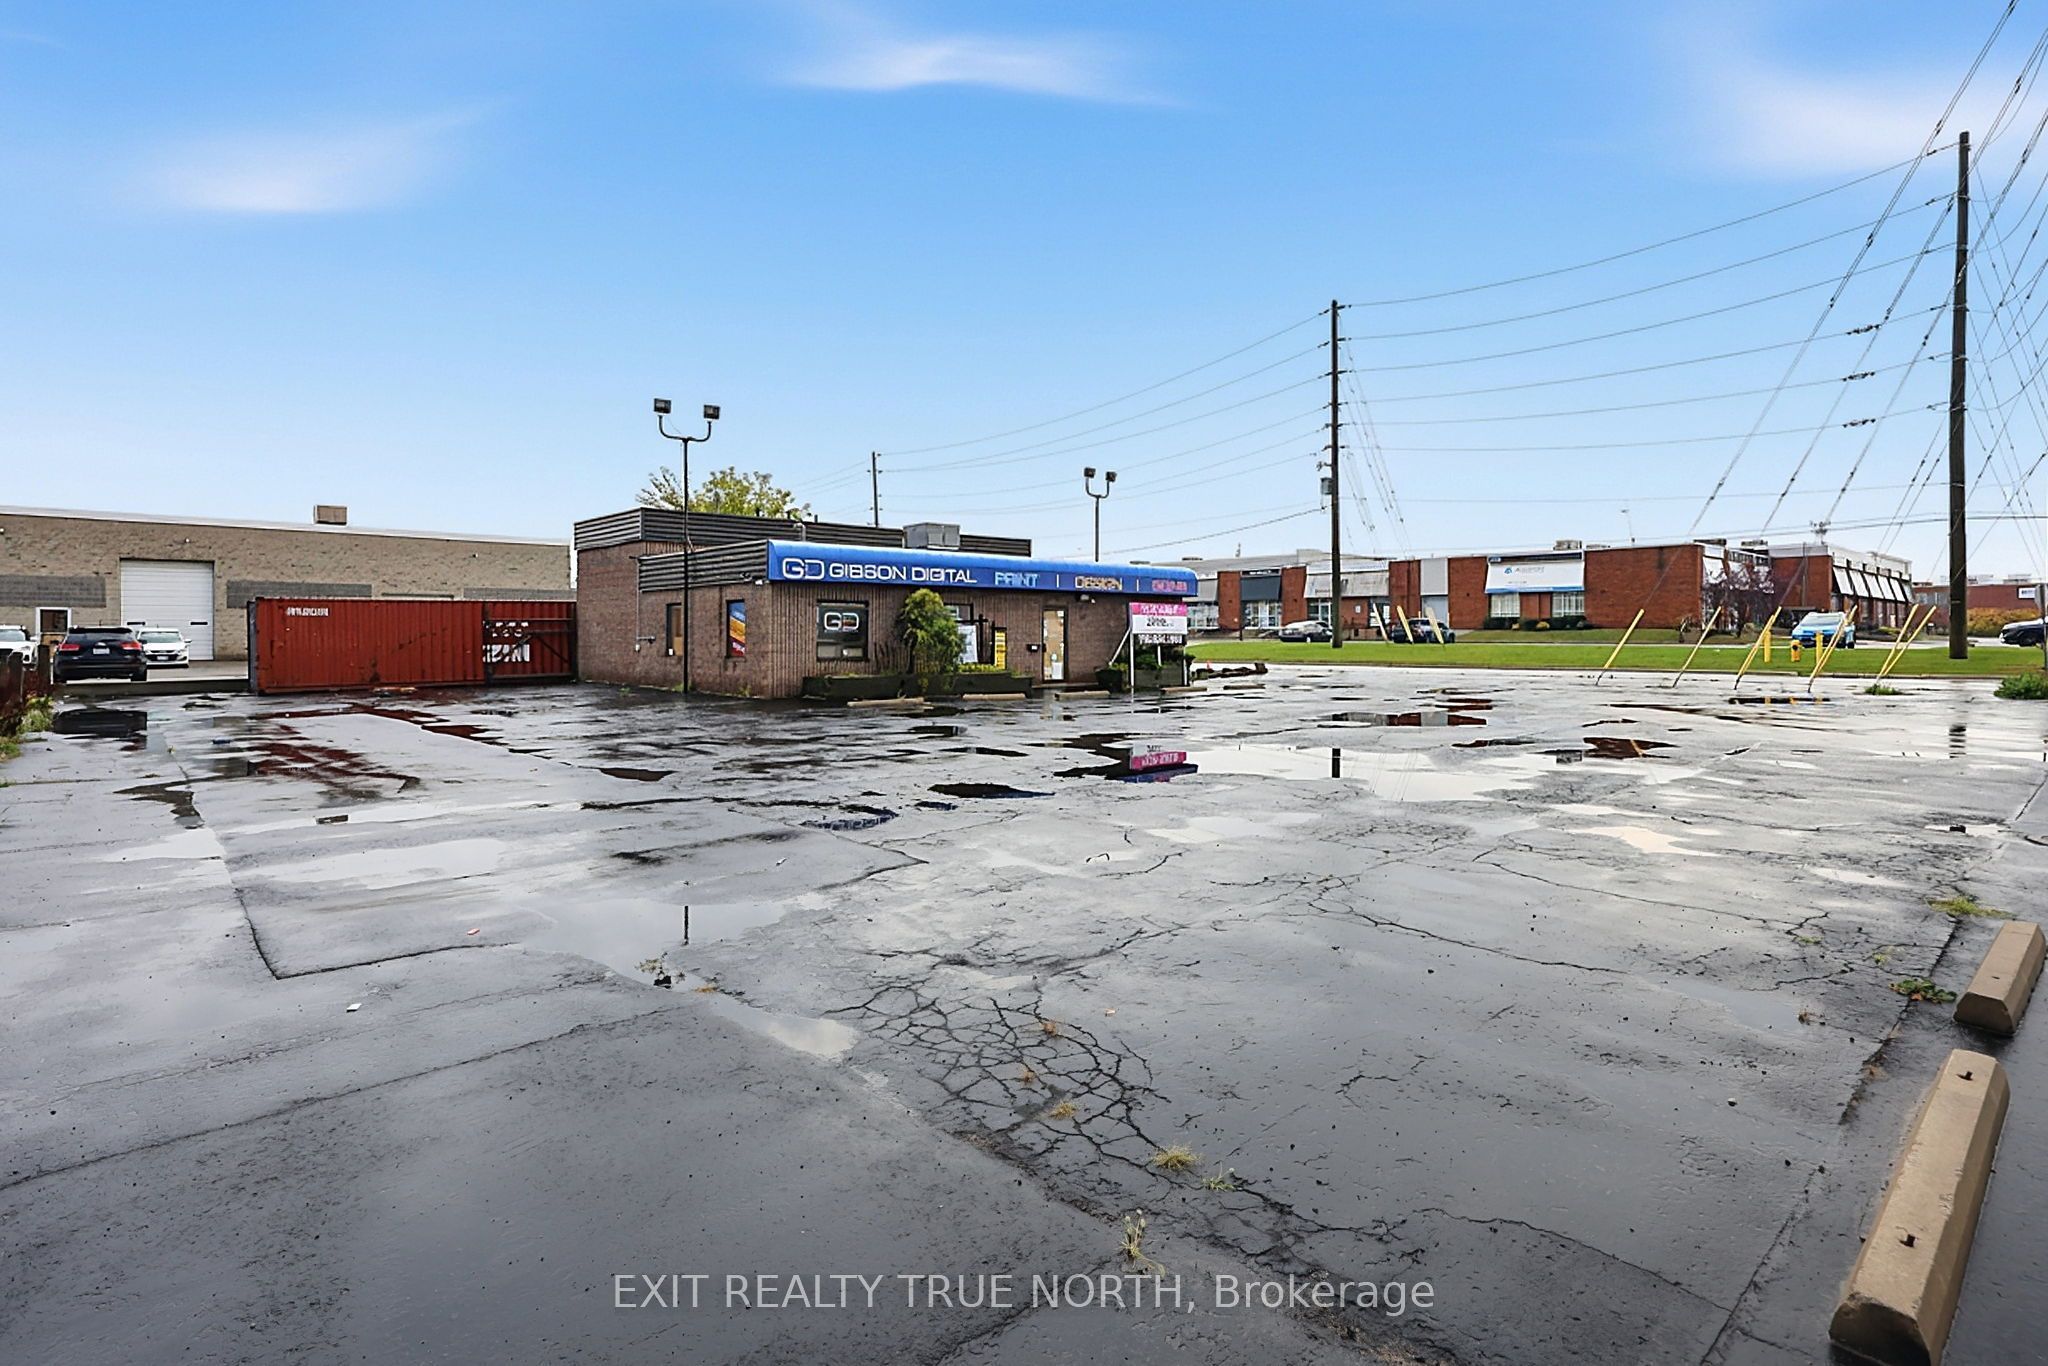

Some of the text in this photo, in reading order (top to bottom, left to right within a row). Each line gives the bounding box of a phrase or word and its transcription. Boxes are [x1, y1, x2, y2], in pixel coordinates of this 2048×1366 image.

[782, 558, 825, 580] GD
[829, 563, 907, 581] GIBSON
[911, 567, 977, 583] DIGITAL
[824, 612, 859, 631] GD
